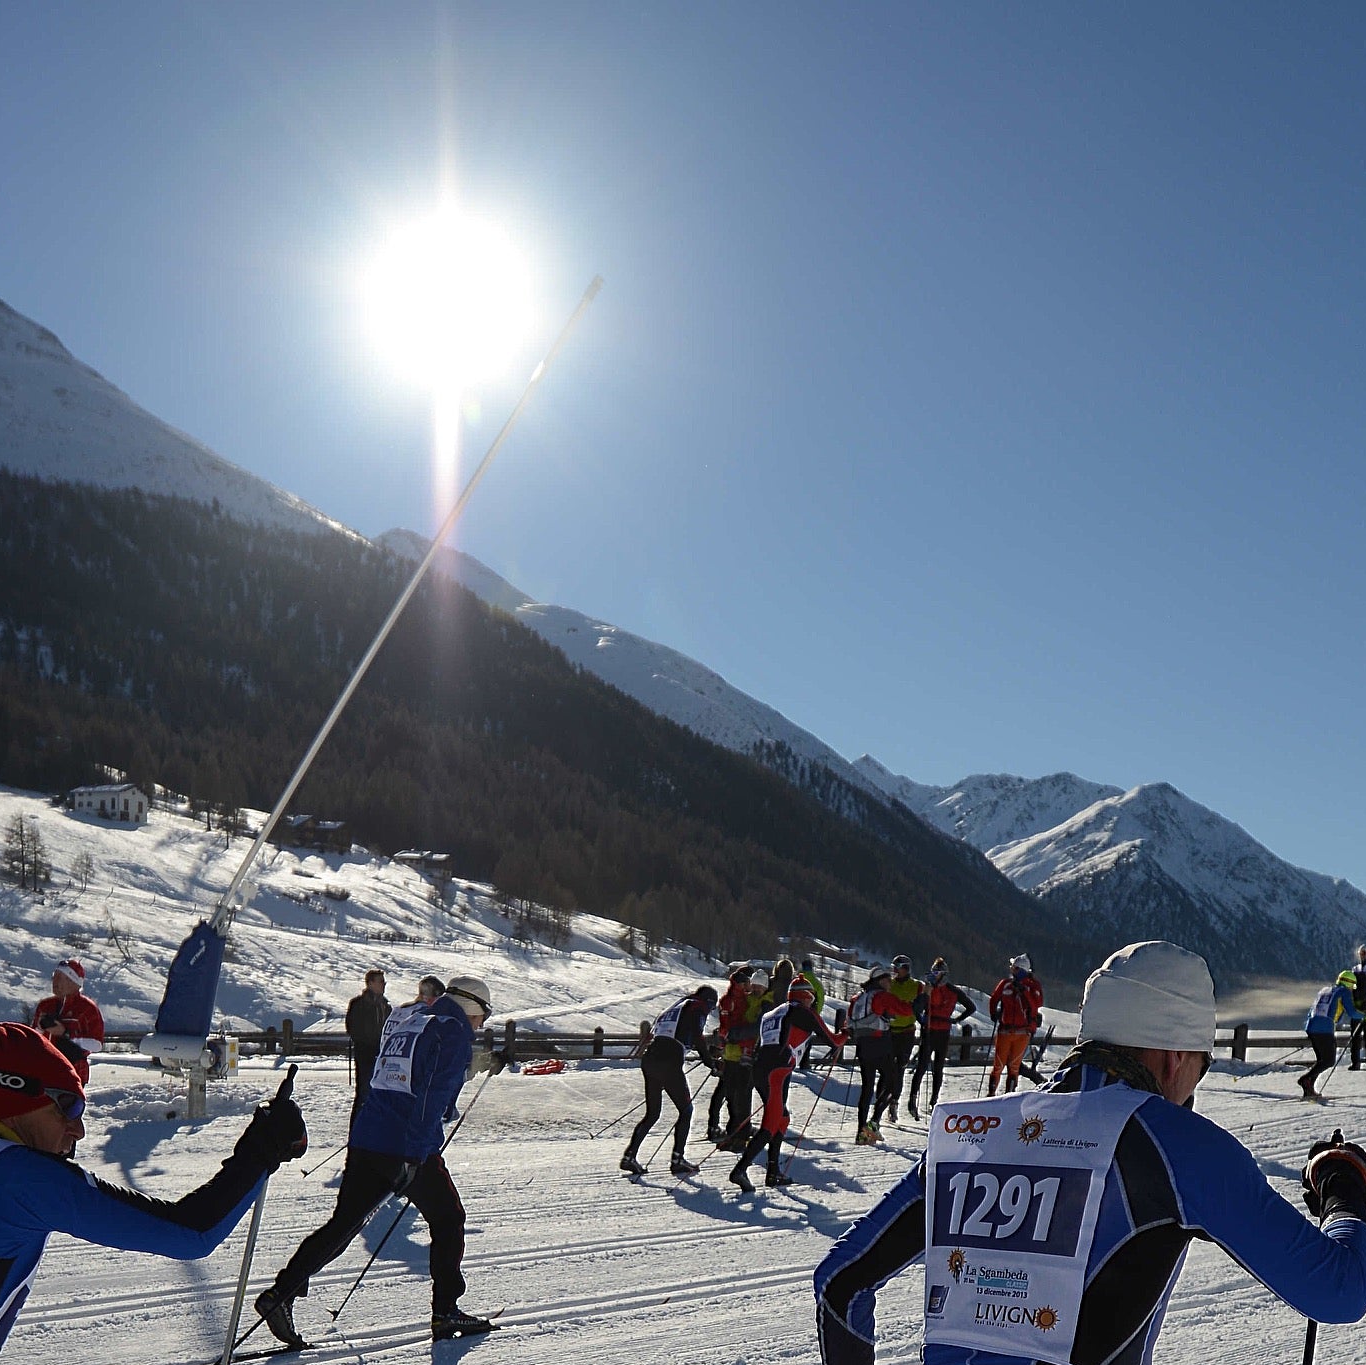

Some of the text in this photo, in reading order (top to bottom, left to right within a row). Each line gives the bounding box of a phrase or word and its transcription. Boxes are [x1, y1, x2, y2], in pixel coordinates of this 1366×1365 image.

[944, 1114, 1001, 1135] COOP
[957, 1134, 986, 1146] Livigno
[1043, 1138, 1066, 1146] Latteria
[1067, 1138, 1075, 1146] di
[1075, 1139, 1099, 1148] Livigno
[948, 1171, 1061, 1242] 1291
[965, 1265, 1028, 1281] La Sgambeda
[976, 1287, 1028, 1299] 13 dicembre 2013
